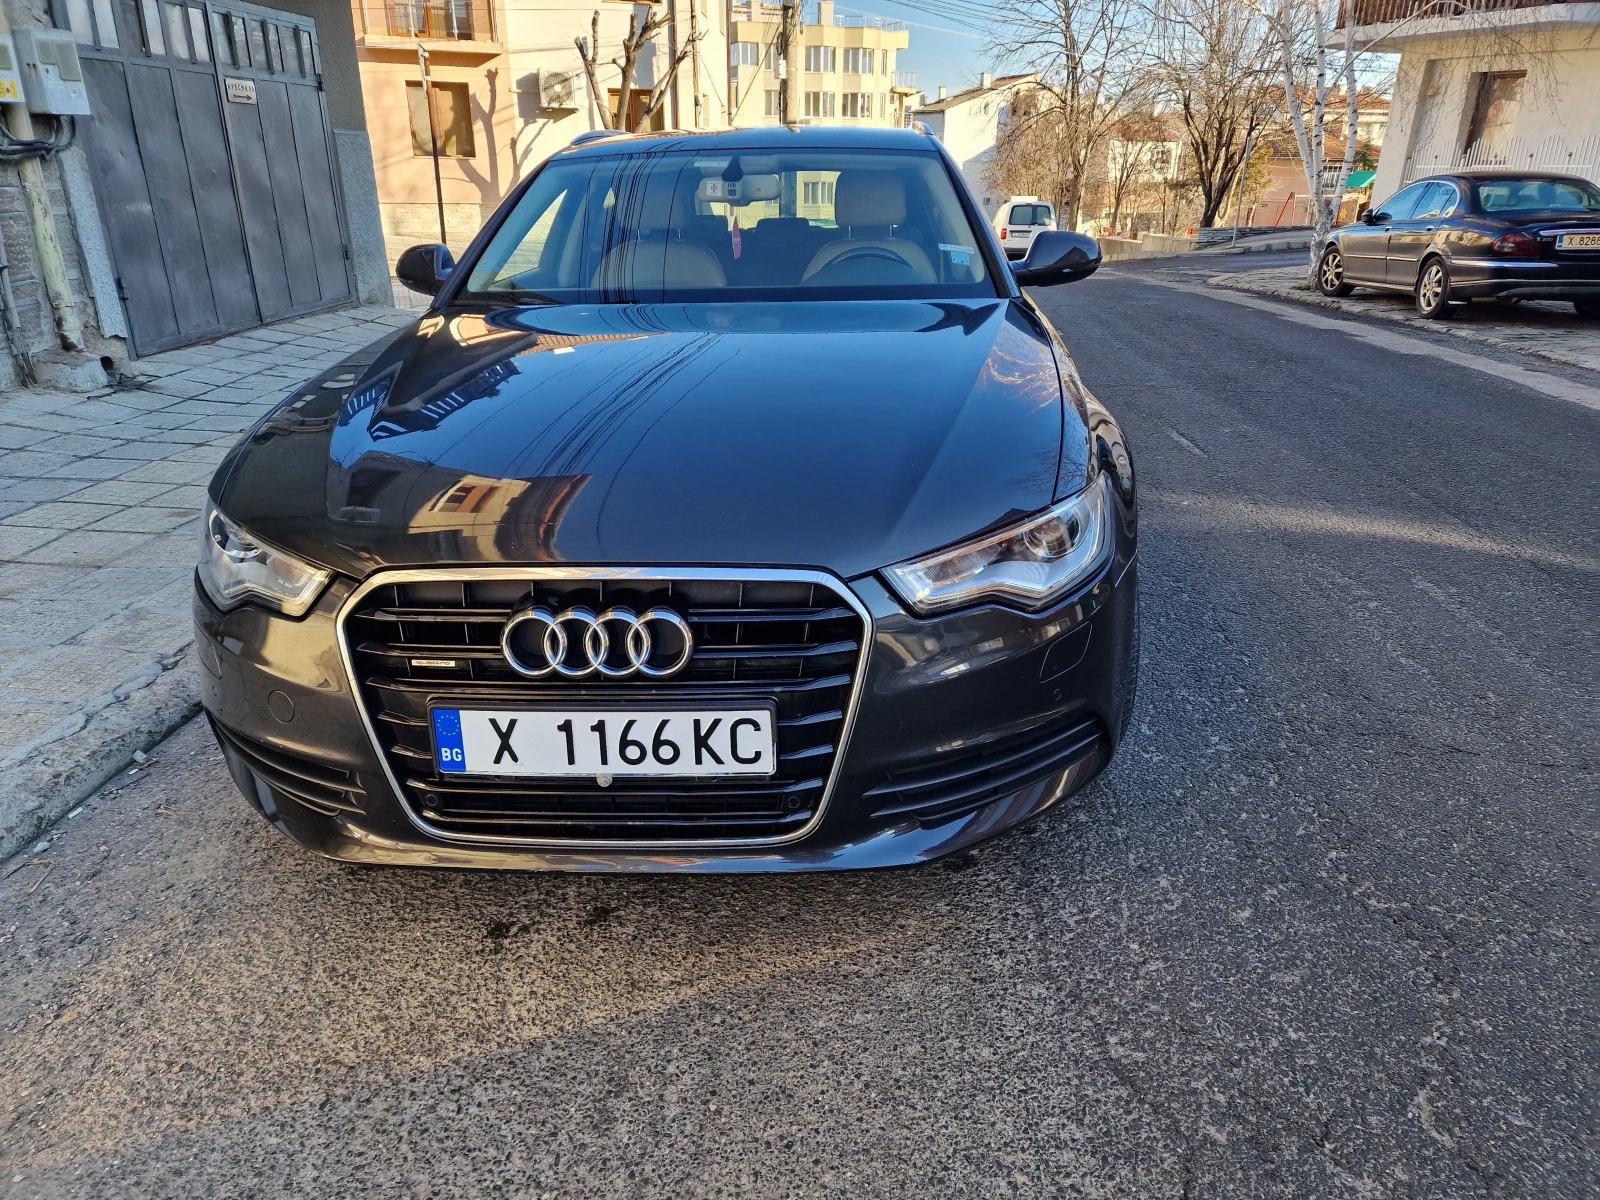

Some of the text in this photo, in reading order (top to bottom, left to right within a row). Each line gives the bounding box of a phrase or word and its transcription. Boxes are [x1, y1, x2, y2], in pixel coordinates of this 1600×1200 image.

[441, 748, 462, 762] BG
[488, 717, 762, 766] X 1166 KC
